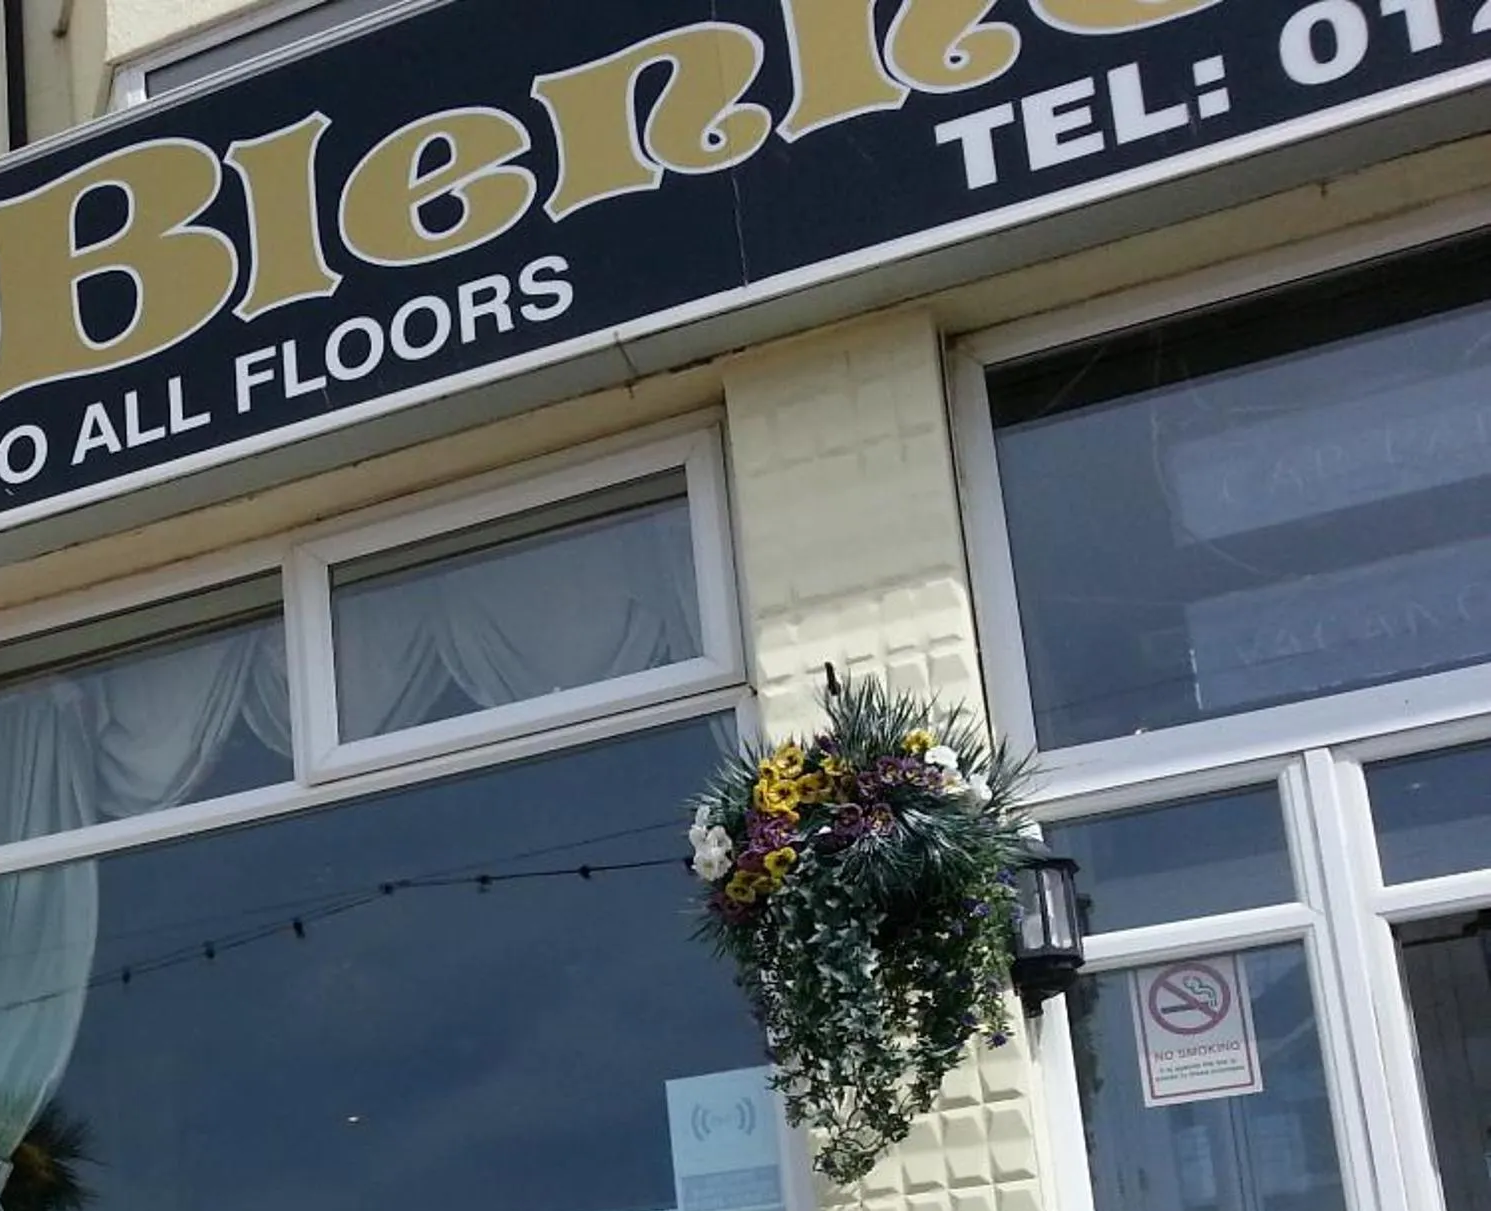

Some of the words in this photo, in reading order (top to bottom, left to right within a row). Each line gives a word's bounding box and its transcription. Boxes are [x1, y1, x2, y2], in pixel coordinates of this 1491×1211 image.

[935, 55, 1231, 190] TEL:
[70, 375, 211, 465] ALL
[234, 254, 575, 413] FLOORS
[1154, 1050, 1174, 1061] NO
